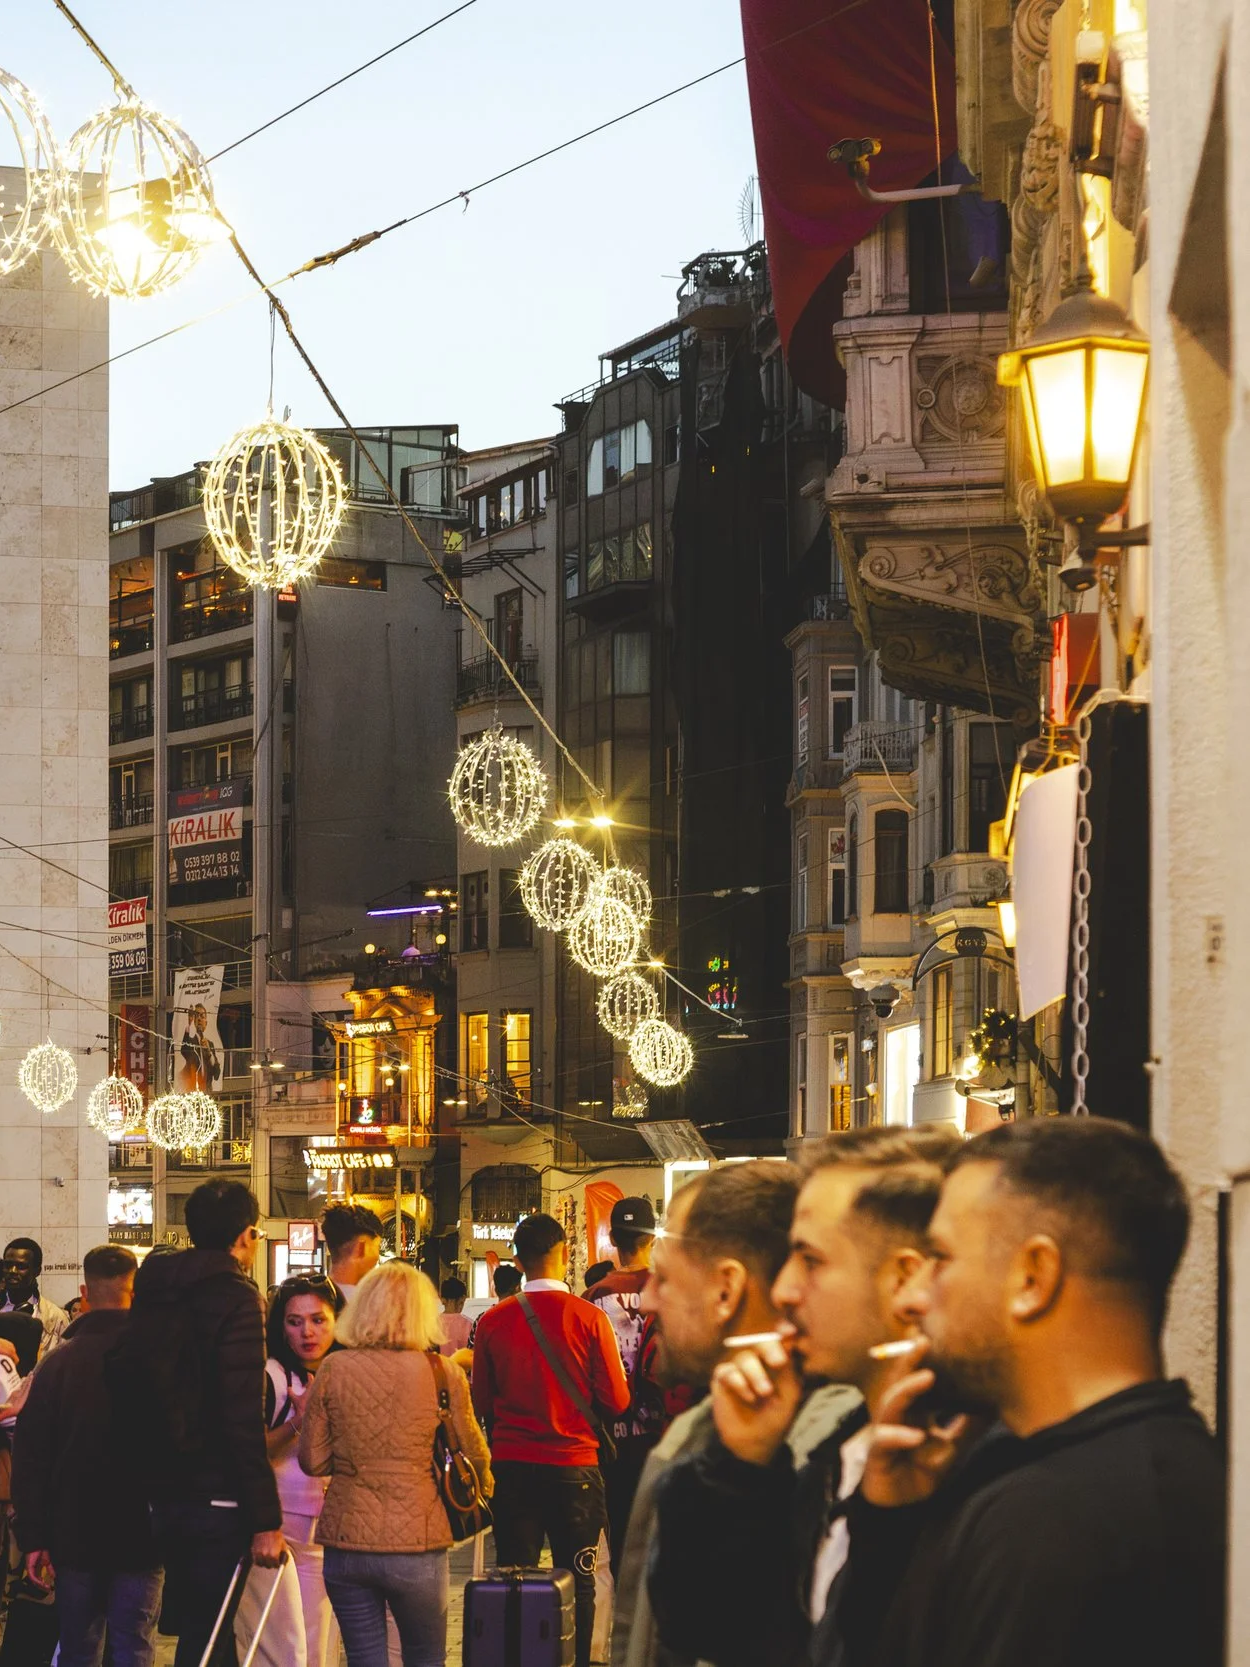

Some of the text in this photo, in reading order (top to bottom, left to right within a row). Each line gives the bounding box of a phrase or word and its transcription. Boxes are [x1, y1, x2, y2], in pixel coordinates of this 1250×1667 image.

[201, 853, 215, 867] 397
[230, 850, 240, 862] 02
[231, 864, 239, 876] 14
[111, 953, 124, 969] 359
[343, 1153, 366, 1168] CAFE
[472, 1224, 515, 1240] Türk Teleko
